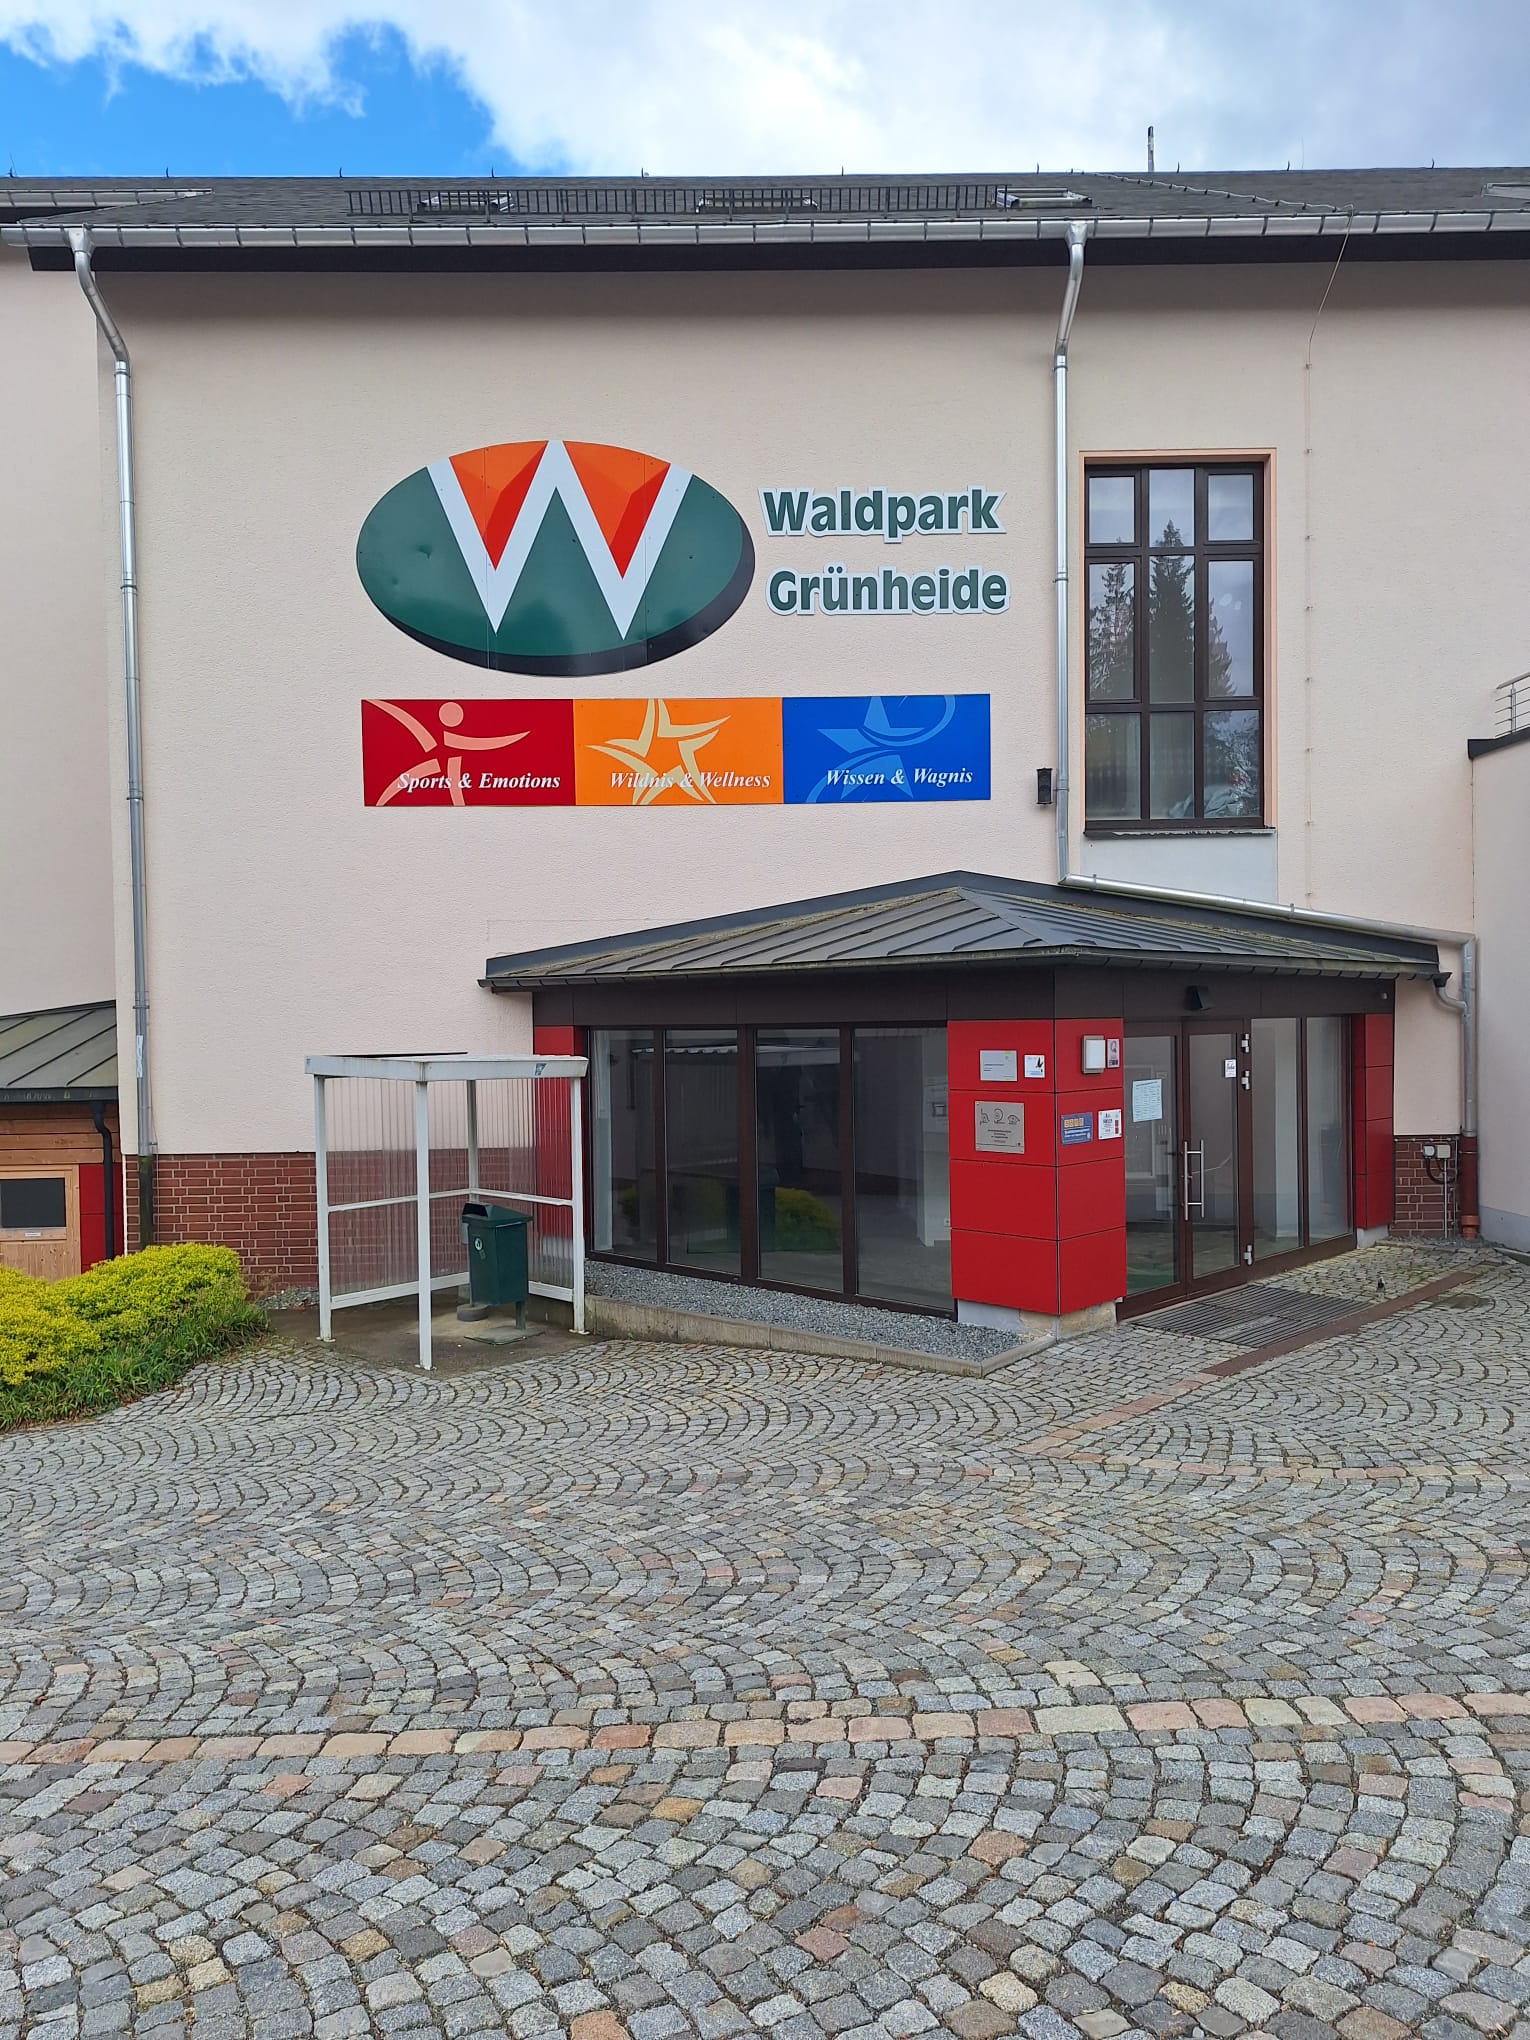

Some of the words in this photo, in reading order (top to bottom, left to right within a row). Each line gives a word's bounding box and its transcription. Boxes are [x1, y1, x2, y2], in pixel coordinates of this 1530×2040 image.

[763, 488, 1000, 538] Waldpark
[769, 566, 1007, 611] Grünheide
[397, 772, 452, 793] Sports
[457, 772, 472, 789] &
[478, 772, 561, 789] Emotions
[610, 771, 673, 789] Wildnis
[679, 771, 694, 788] &
[700, 771, 771, 788] Wellness
[826, 769, 885, 785] Wissen
[890, 768, 905, 785] &
[913, 767, 974, 788] Wagnis
